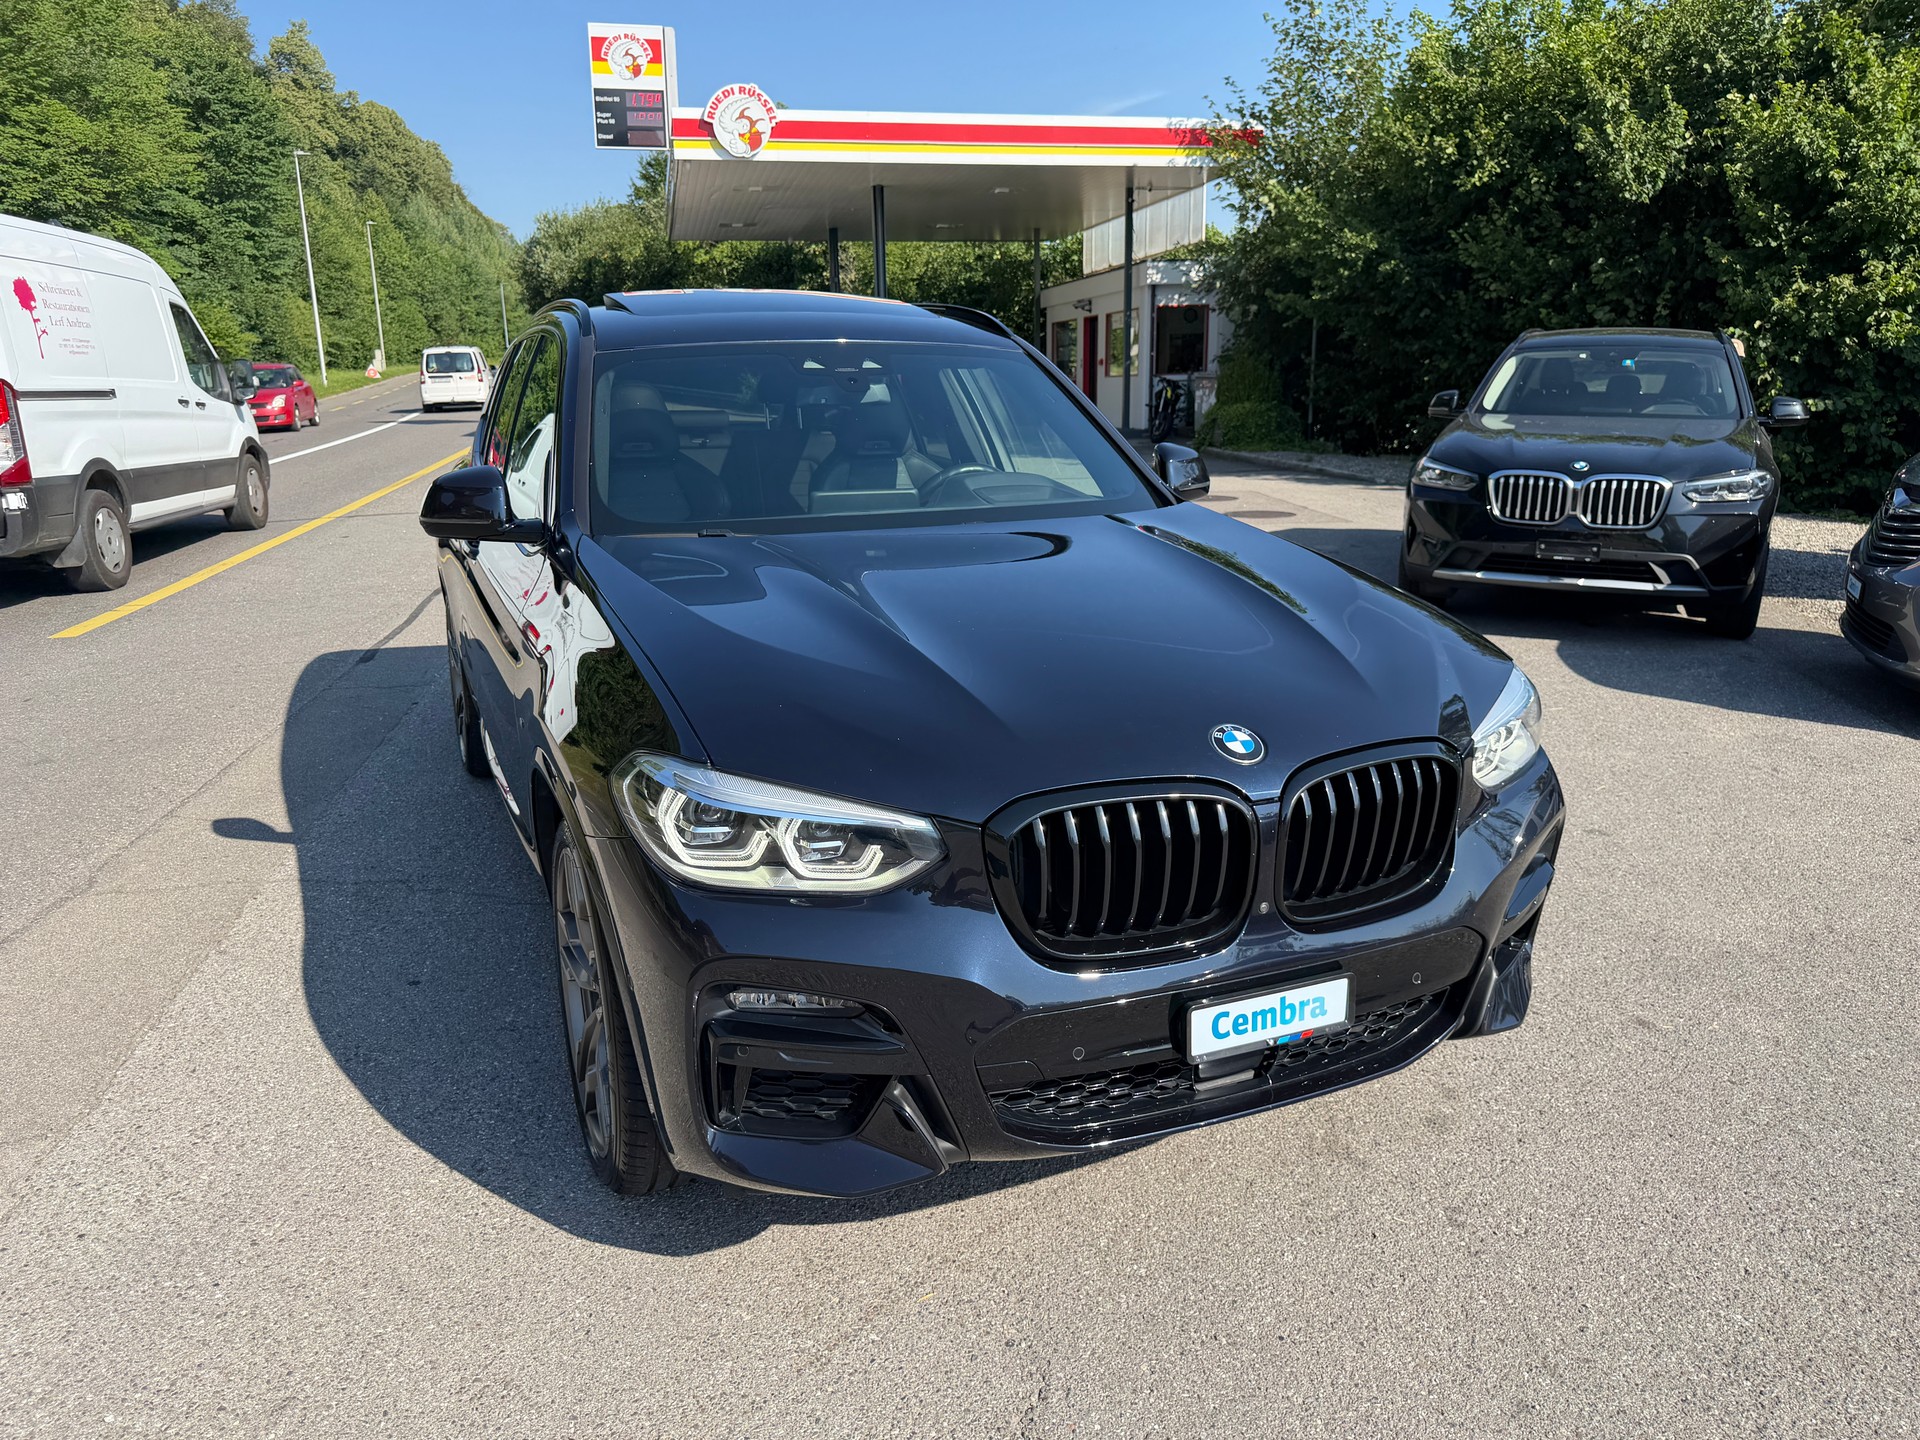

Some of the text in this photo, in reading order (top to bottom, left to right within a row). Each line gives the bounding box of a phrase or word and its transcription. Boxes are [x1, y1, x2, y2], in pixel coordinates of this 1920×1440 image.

[603, 33, 652, 59] RUEDI RÜSSEL
[707, 85, 777, 123] RUEDI RÜSSEL
[1211, 996, 1327, 1040] Cembra
